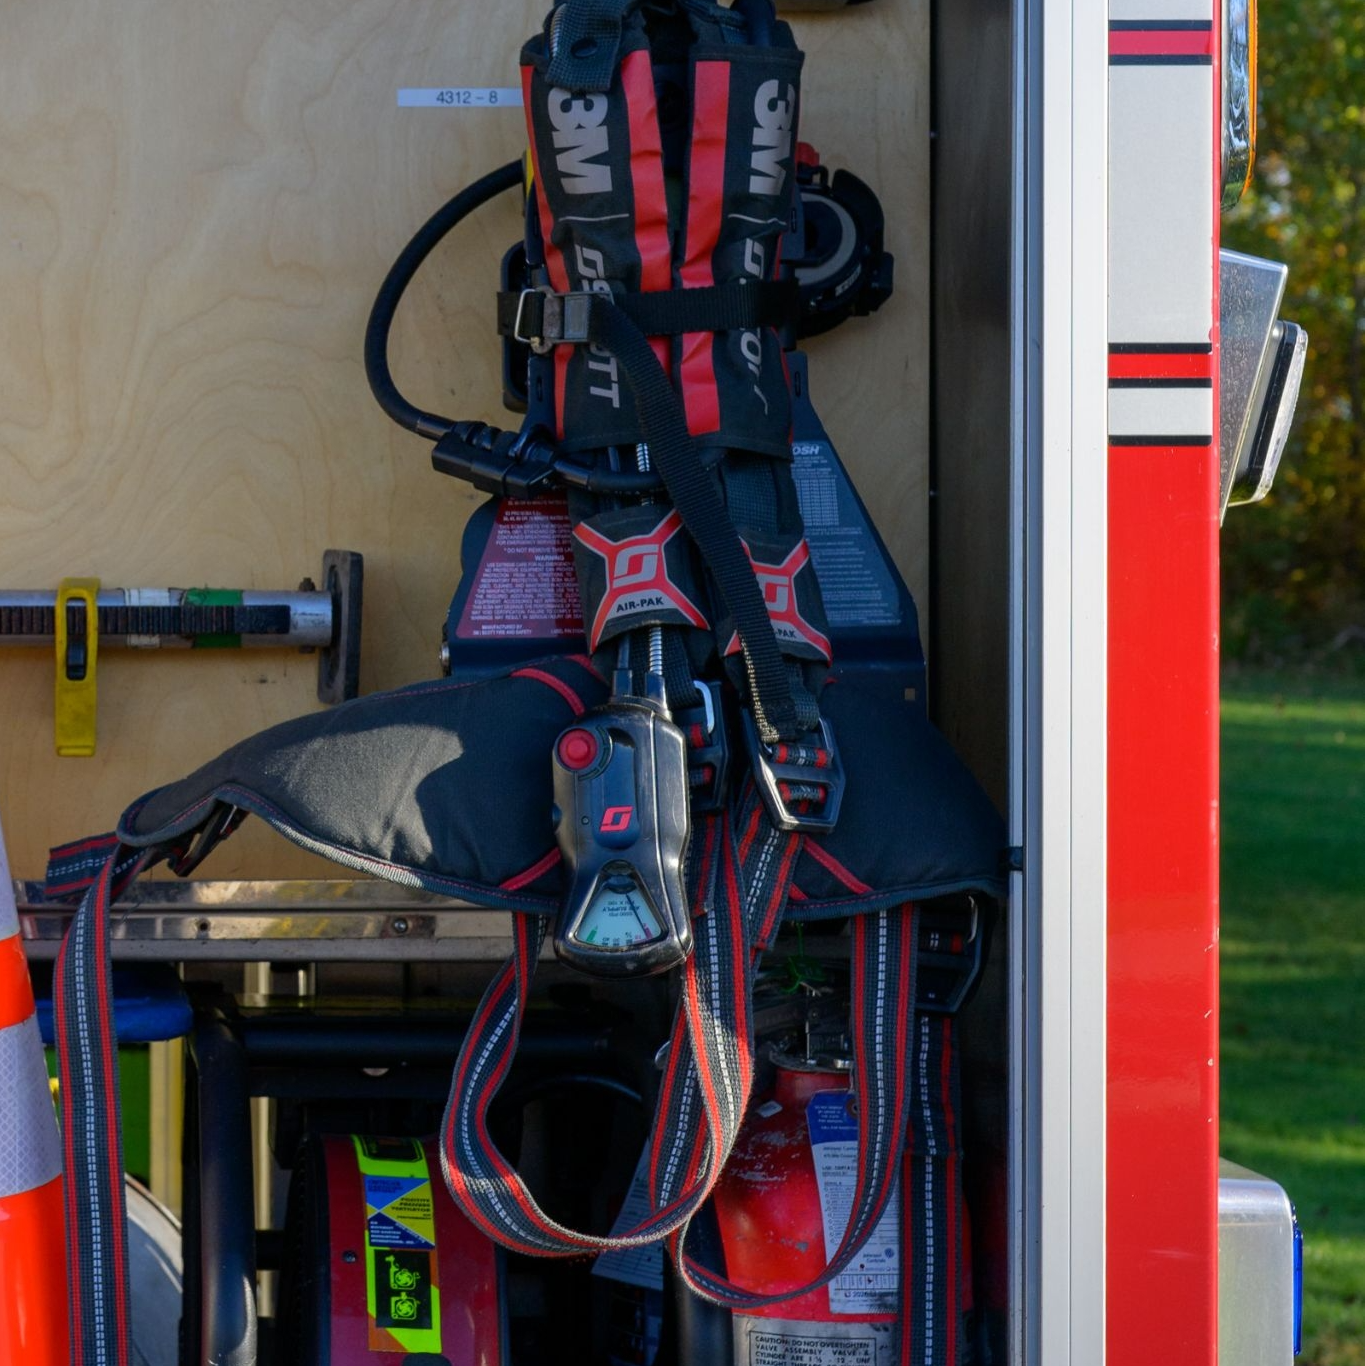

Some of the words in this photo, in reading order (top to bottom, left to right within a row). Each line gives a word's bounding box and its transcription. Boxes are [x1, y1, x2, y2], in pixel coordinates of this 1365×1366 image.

[436, 90, 471, 104] 4312
[489, 90, 498, 104] 8
[547, 87, 613, 195] 3M
[748, 79, 797, 196] 3M
[792, 445, 820, 456] OSH
[616, 596, 664, 613] AIR-PAK
[774, 630, 796, 638] -PAK
[756, 1351, 785, 1359] CYLINDER
[756, 1359, 786, 1366] STRAIGHT
